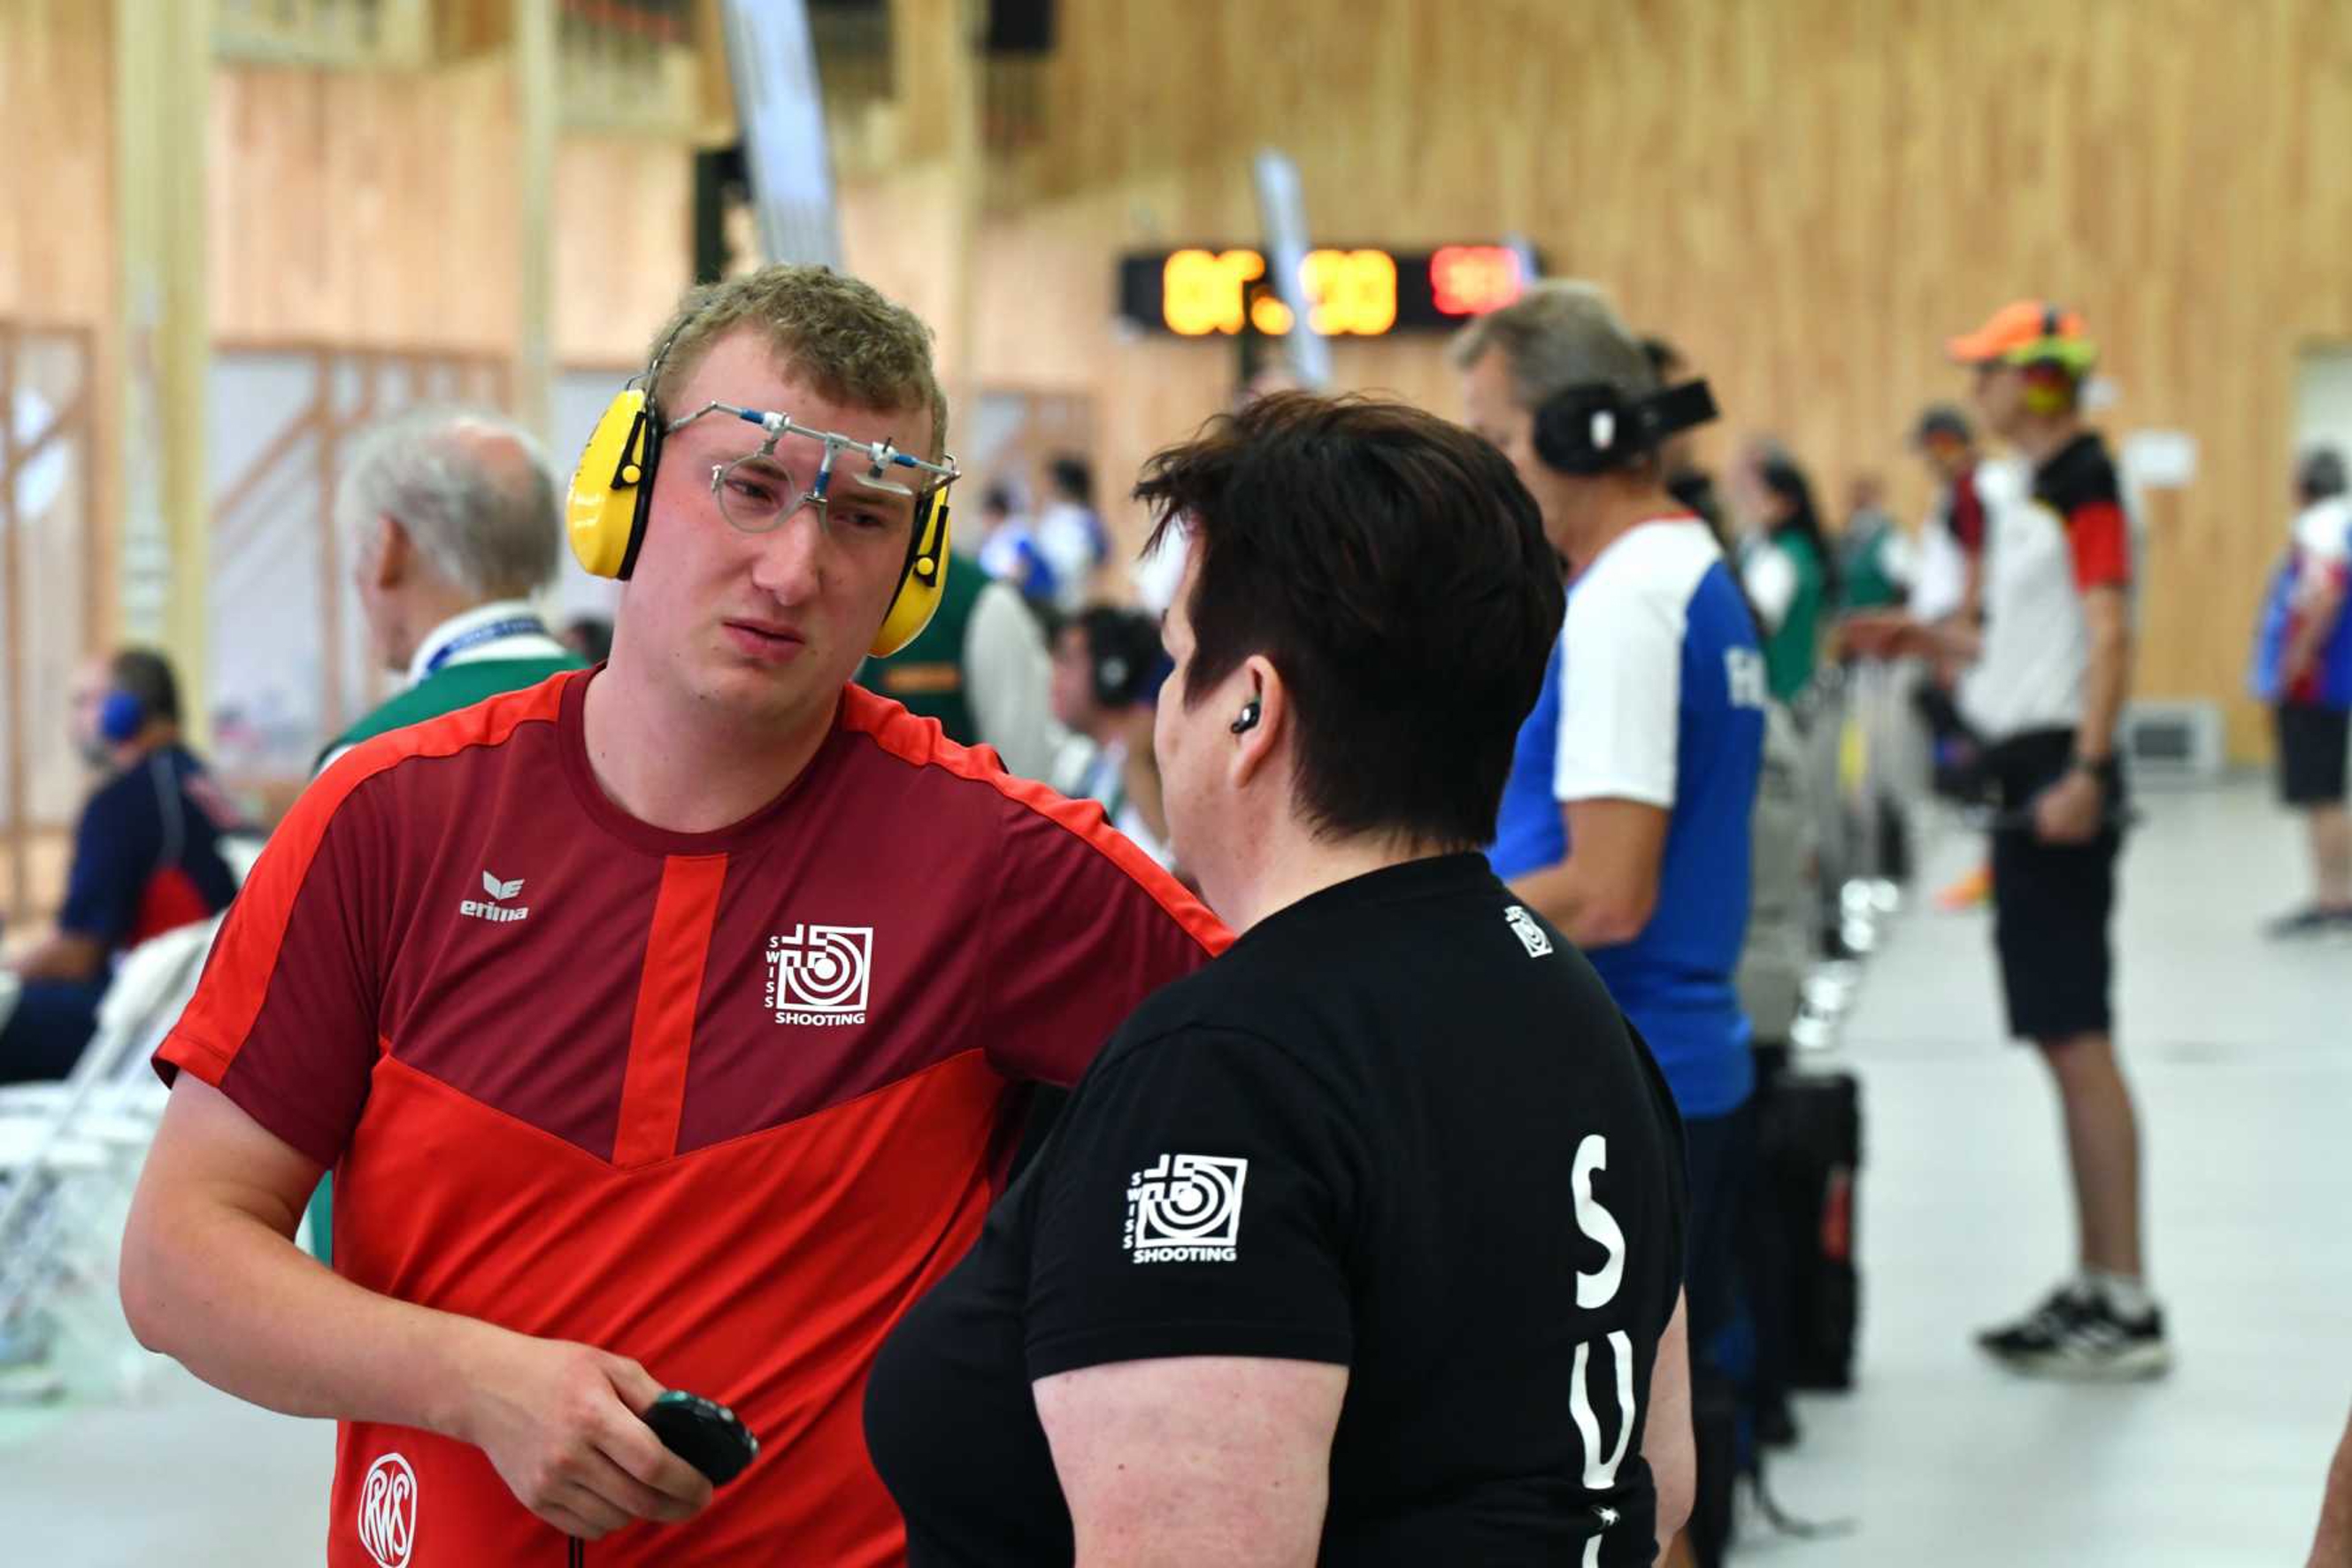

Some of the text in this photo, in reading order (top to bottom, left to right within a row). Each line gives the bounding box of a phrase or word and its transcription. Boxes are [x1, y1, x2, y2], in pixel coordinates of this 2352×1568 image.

[460, 900, 529, 922] erima
[765, 936, 780, 1009] SWISS
[775, 1011, 865, 1026] SHOOTING
[1122, 1172, 1142, 1249] SWISS
[1133, 1247, 1237, 1264] SHOOTING
